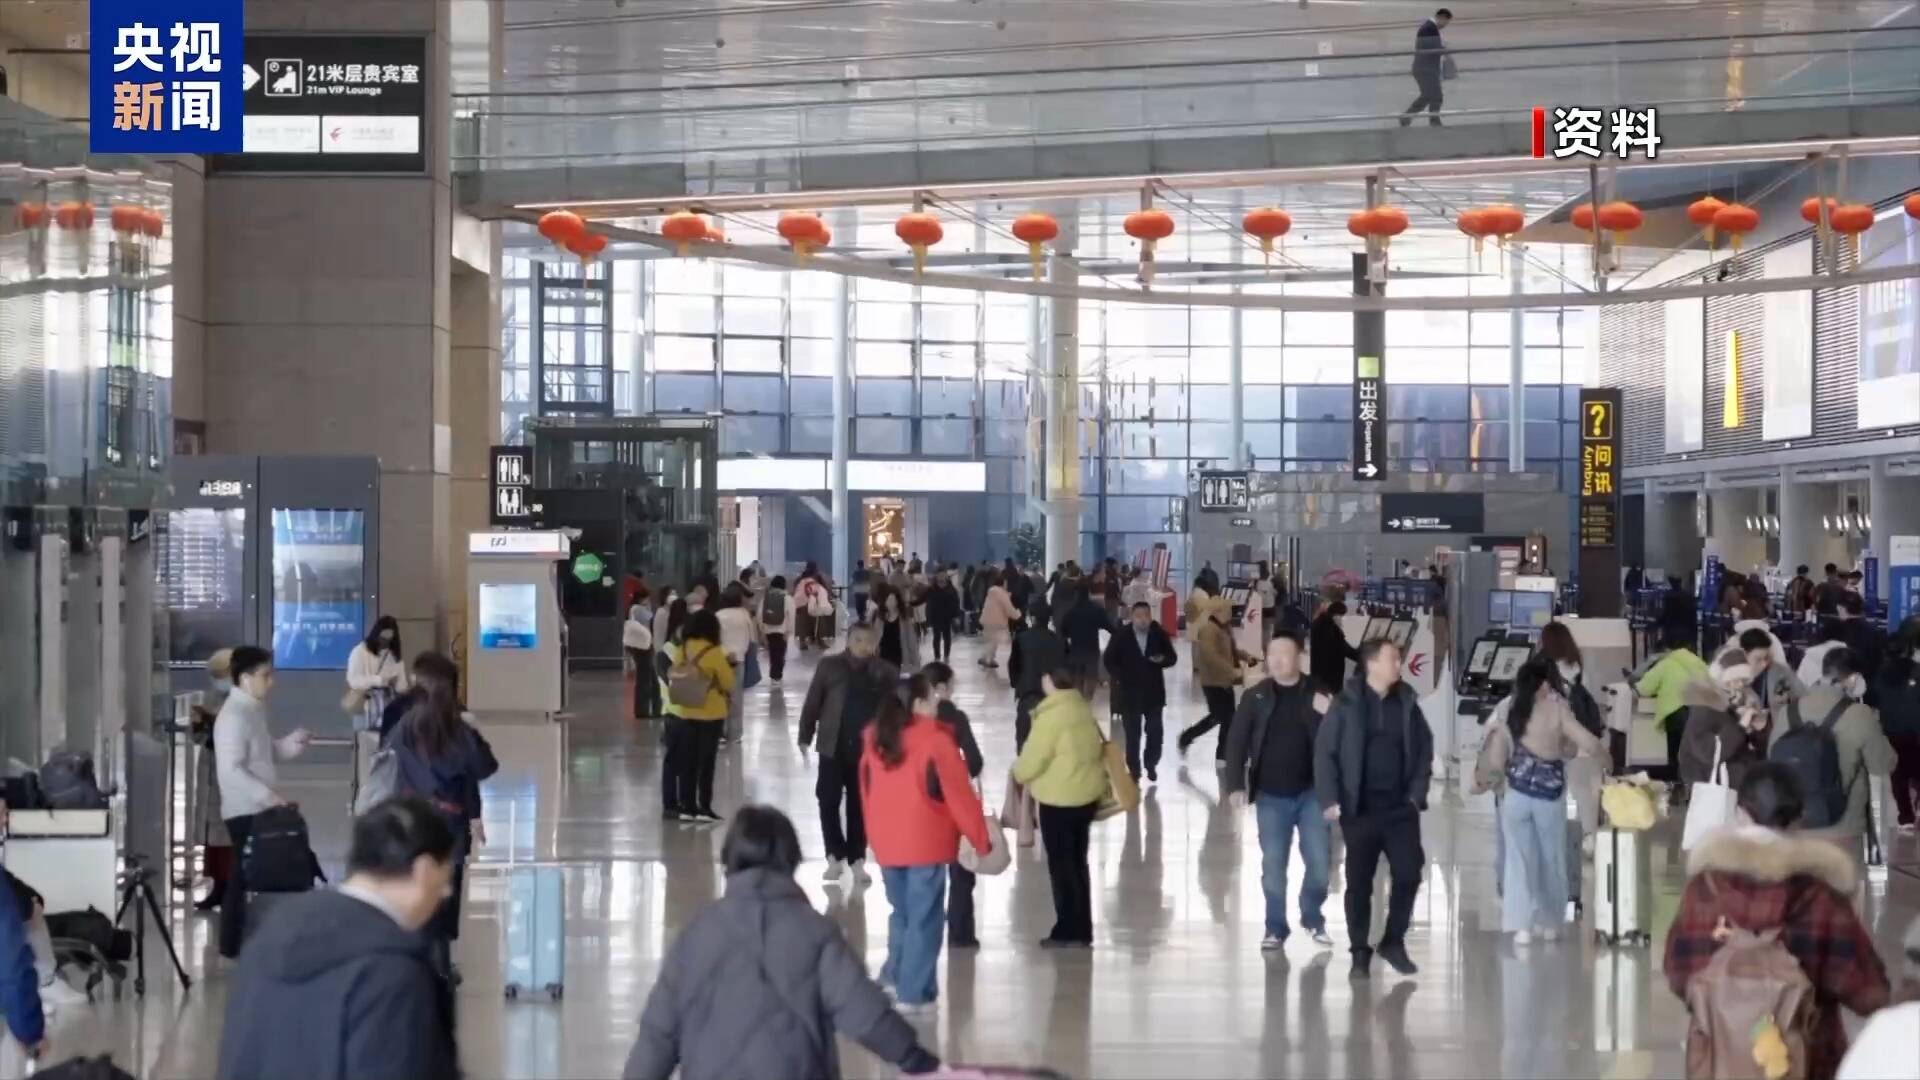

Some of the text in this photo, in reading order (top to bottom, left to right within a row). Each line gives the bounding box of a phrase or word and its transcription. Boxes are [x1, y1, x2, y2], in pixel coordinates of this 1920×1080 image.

[307, 64, 419, 83] 21米层贵宾室
[307, 86, 382, 96] 21m VIP Lounge
[1359, 381, 1378, 420] 出发
[1582, 446, 1594, 495] Enquiry
[1595, 445, 1612, 493] 问讯
